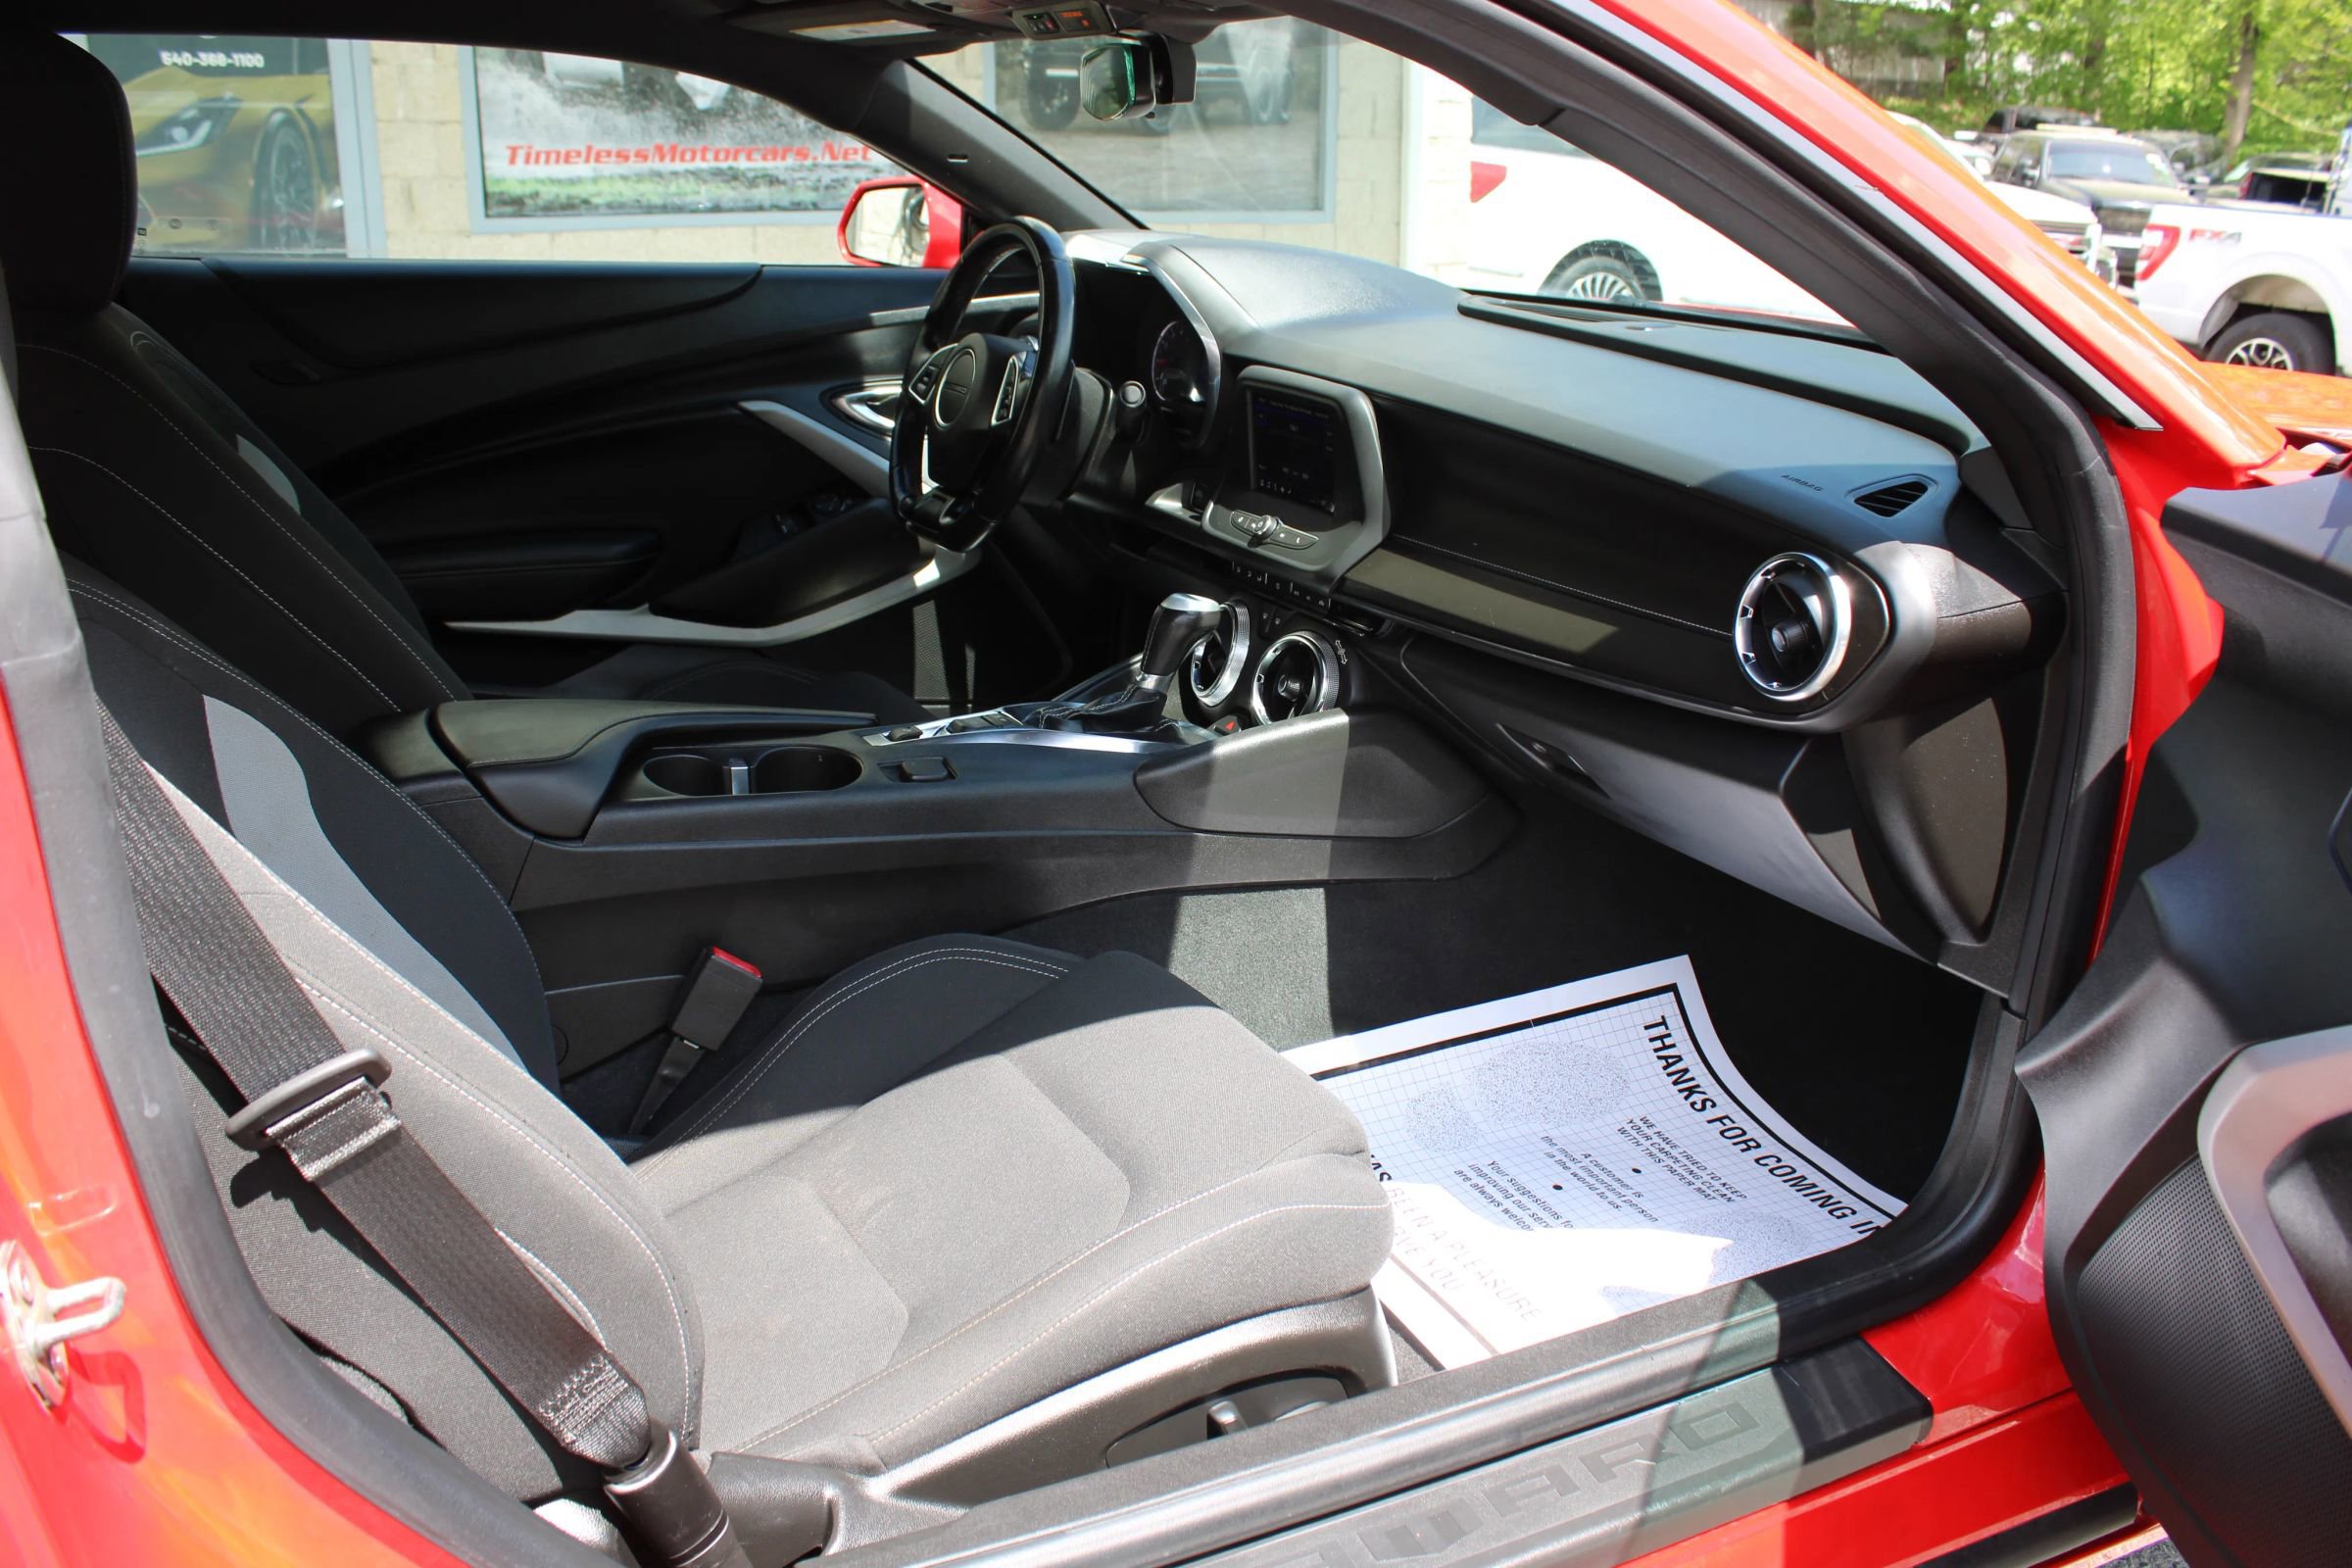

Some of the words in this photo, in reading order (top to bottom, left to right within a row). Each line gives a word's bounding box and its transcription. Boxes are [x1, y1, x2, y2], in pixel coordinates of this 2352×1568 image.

[506, 141, 874, 166] TimelessMotorcars.Net
[2189, 228, 2242, 243] FX4
[1780, 474, 1824, 492] AIRBAG
[1643, 1015, 1717, 1112] THANKS
[1706, 1114, 1762, 1153] FOR
[1753, 1154, 1857, 1219] COMING
[1468, 1162, 1514, 1200] improving
[1512, 1199, 1532, 1213] our
[1541, 1135, 1558, 1150] the
[1557, 1147, 1583, 1165] most
[1579, 1163, 1629, 1200] important
[1621, 1198, 1659, 1223] person
[1544, 1152, 1556, 1160] in
[1554, 1157, 1572, 1172] the
[1569, 1170, 1599, 1193] world
[1595, 1190, 1608, 1200] to
[1607, 1200, 1622, 1212] us.
[1589, 1157, 1634, 1192] customer
[1631, 1190, 1644, 1200] is
[1617, 1127, 1646, 1149] WITH
[1643, 1146, 1663, 1164] THIS
[1663, 1164, 1696, 1188] PAPER
[1692, 1186, 1717, 1201] MAT
[1626, 1118, 1651, 1143] YOUR
[1649, 1142, 1703, 1182] CARPETING
[1700, 1179, 1736, 1202] CLEAN
[1640, 1115, 1656, 1130] WE
[1655, 1129, 1680, 1151] HAVE
[1678, 1147, 1708, 1172] TRIED
[1707, 1170, 1722, 1182] TO
[1719, 1180, 1748, 1200] KEEP
[1453, 1168, 1472, 1183] are
[1469, 1181, 1503, 1208] always
[1487, 1159, 1509, 1178] Your
[1506, 1177, 1563, 1221] suggestions
[1386, 1187, 1435, 1228] BEEN
[1427, 1230, 1448, 1243] A
[1445, 1240, 1544, 1321] PLEASURE
[1420, 1257, 1465, 1292] YOU
